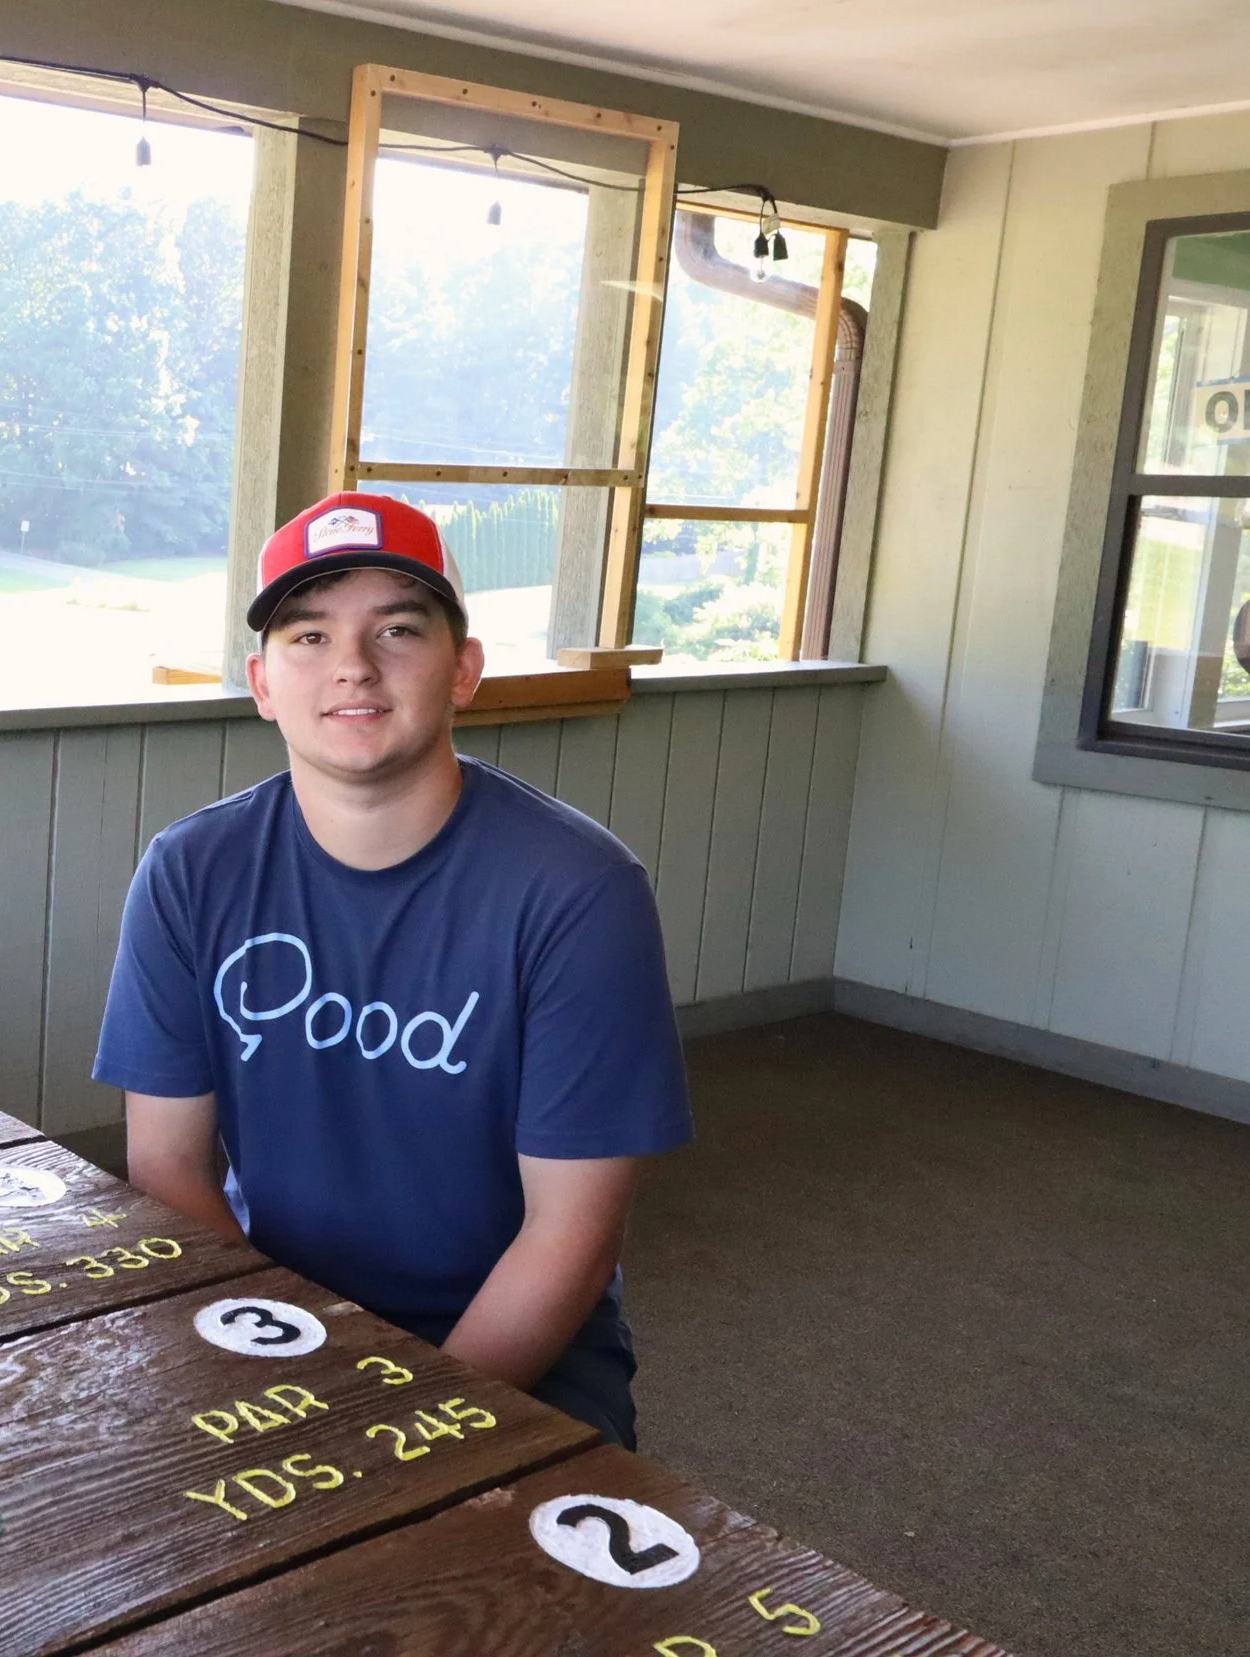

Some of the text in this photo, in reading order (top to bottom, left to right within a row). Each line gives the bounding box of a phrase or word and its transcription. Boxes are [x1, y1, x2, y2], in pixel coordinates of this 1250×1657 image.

[1205, 388, 1250, 434] O
[78, 1207, 127, 1228] 4
[65, 1237, 183, 1279] 330
[220, 1306, 301, 1346] 3
[191, 1356, 414, 1444] PAR 3
[182, 1397, 497, 1521] YDS. 245
[555, 1503, 680, 1575] 2
[749, 1587, 821, 1636] 5
